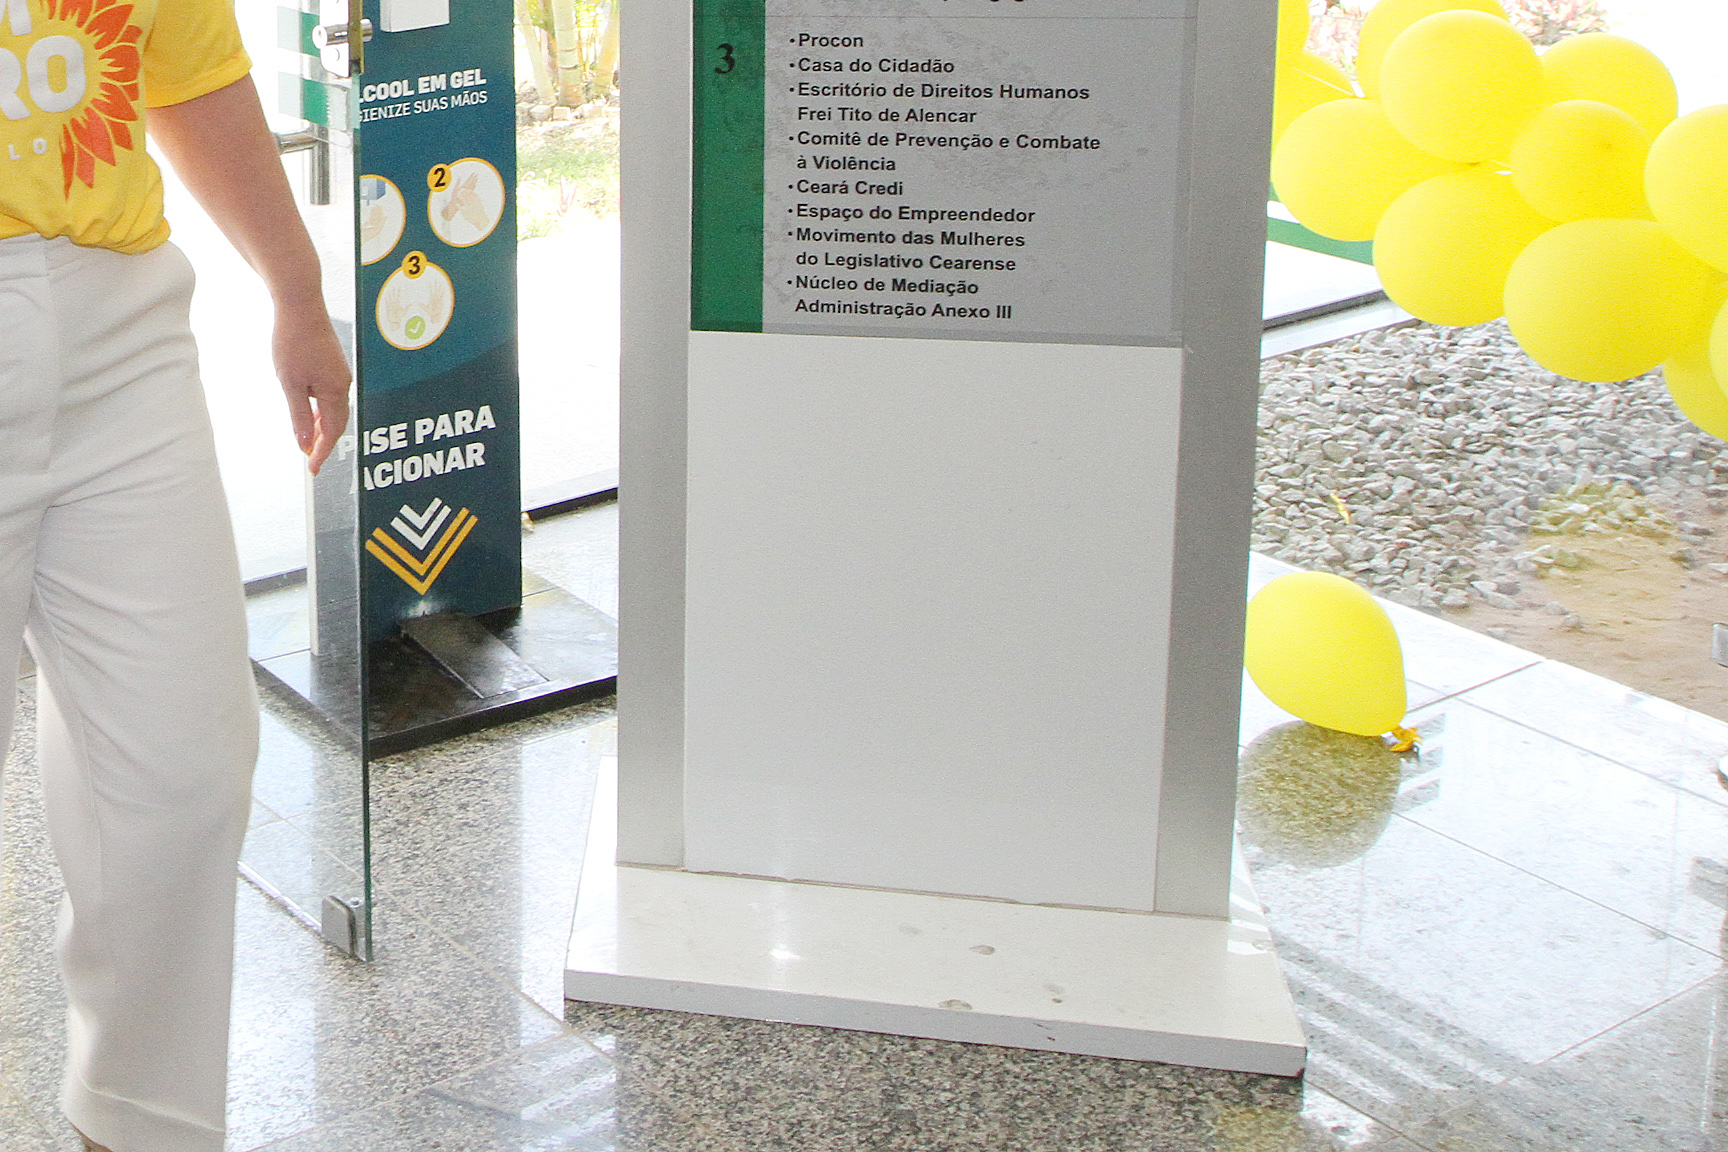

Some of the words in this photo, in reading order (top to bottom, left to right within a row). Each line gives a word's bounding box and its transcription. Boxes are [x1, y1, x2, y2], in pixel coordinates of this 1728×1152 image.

[799, 33, 864, 48] Procon
[715, 43, 735, 74] 3
[799, 58, 843, 73] Casa
[850, 58, 872, 73] do
[878, 58, 955, 74] Cidadão
[418, 74, 446, 94] EM
[450, 68, 486, 88] GEL
[798, 82, 886, 99] Escritório
[893, 83, 915, 98] de
[921, 83, 993, 99] Direitos
[1000, 84, 1090, 99] Humanos
[414, 96, 448, 114] SUAS
[451, 91, 488, 108] MÃOS
[798, 106, 832, 122] Frei
[838, 107, 872, 122] Tito
[878, 107, 900, 122] de
[905, 108, 977, 123] Alencar
[797, 131, 861, 147] Comitê
[868, 132, 889, 147] de
[896, 132, 993, 151] Prevenção
[999, 137, 1009, 149] e
[1016, 135, 1100, 150] Combate
[797, 155, 807, 170] à
[813, 156, 896, 171] Violência
[434, 167, 446, 187] 2
[797, 180, 849, 195] Ceará
[855, 180, 903, 196] Credi
[797, 204, 863, 222] Espaço
[870, 205, 892, 220] do
[899, 206, 1036, 226] Empreendedor
[797, 228, 896, 244] Movimento
[902, 230, 934, 245] das
[941, 231, 1025, 247] Mulheres
[408, 255, 421, 276] 3
[796, 251, 818, 266] do
[825, 252, 923, 272] Legislativo
[929, 255, 1016, 271] Cearense
[796, 276, 858, 292] Núcleo
[864, 277, 886, 292] de
[892, 279, 979, 297] Mediação
[795, 300, 926, 318] Administração
[932, 303, 990, 318] Anexo
[996, 304, 1012, 319] III
[415, 405, 496, 444] PARA
